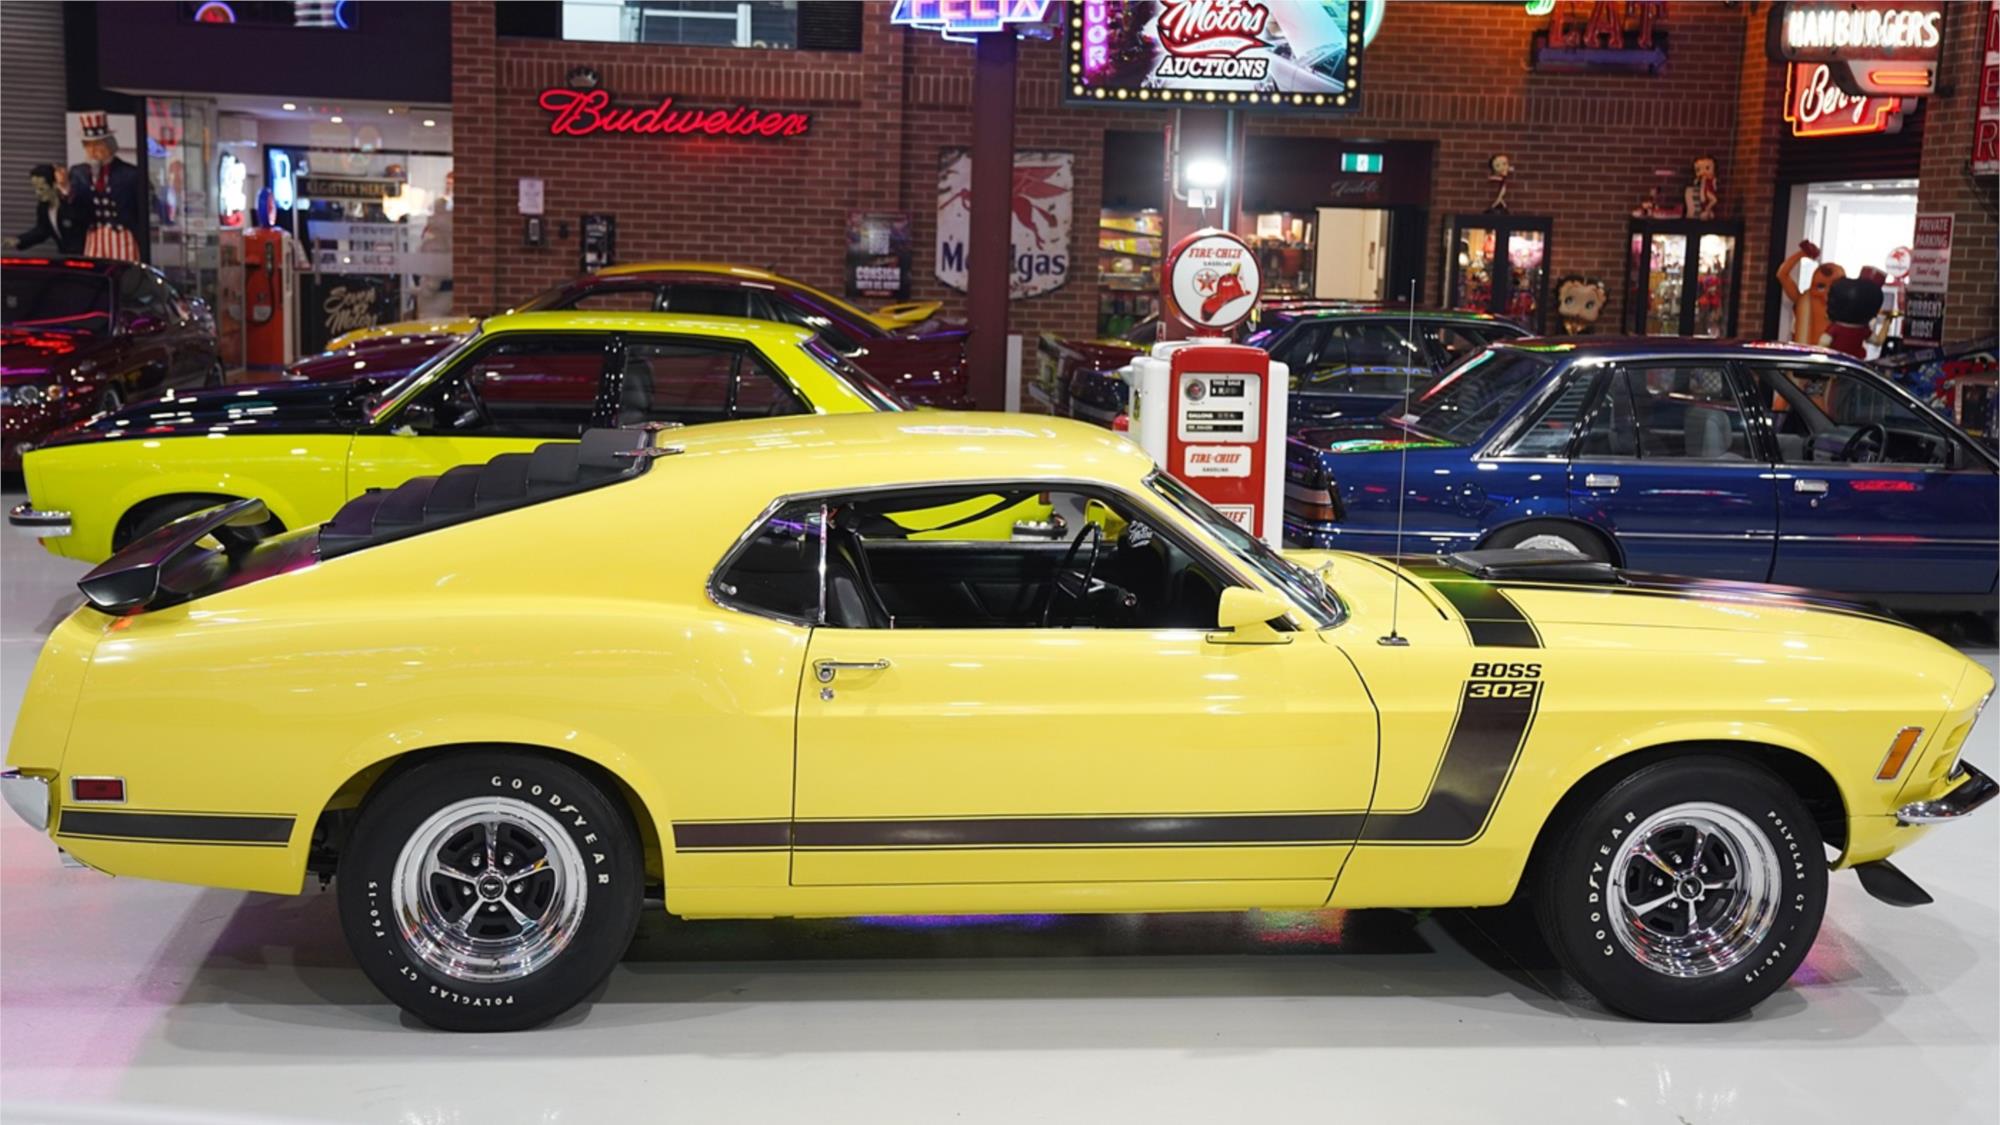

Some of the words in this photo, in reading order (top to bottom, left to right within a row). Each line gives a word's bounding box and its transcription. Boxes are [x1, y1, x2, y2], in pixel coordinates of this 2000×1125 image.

[1162, 1, 1264, 41] Motors
[1789, 9, 1941, 47] HAMBURGERS
[1158, 57, 1265, 78] AUCTIONS
[539, 89, 808, 136] Budweiser
[941, 241, 1065, 283] Mlgas
[1190, 453, 1242, 463] FIRE-CHIEF
[1470, 663, 1542, 678] BOSS
[1469, 683, 1533, 698] 302
[491, 775, 610, 886] GOODYEAR
[1766, 810, 1806, 881] POLYGLAS
[1794, 893, 1806, 912] GT
[1588, 811, 1637, 957] GOODYEAR
[399, 965, 419, 982] GT
[429, 984, 515, 1008] POLYGLAS
